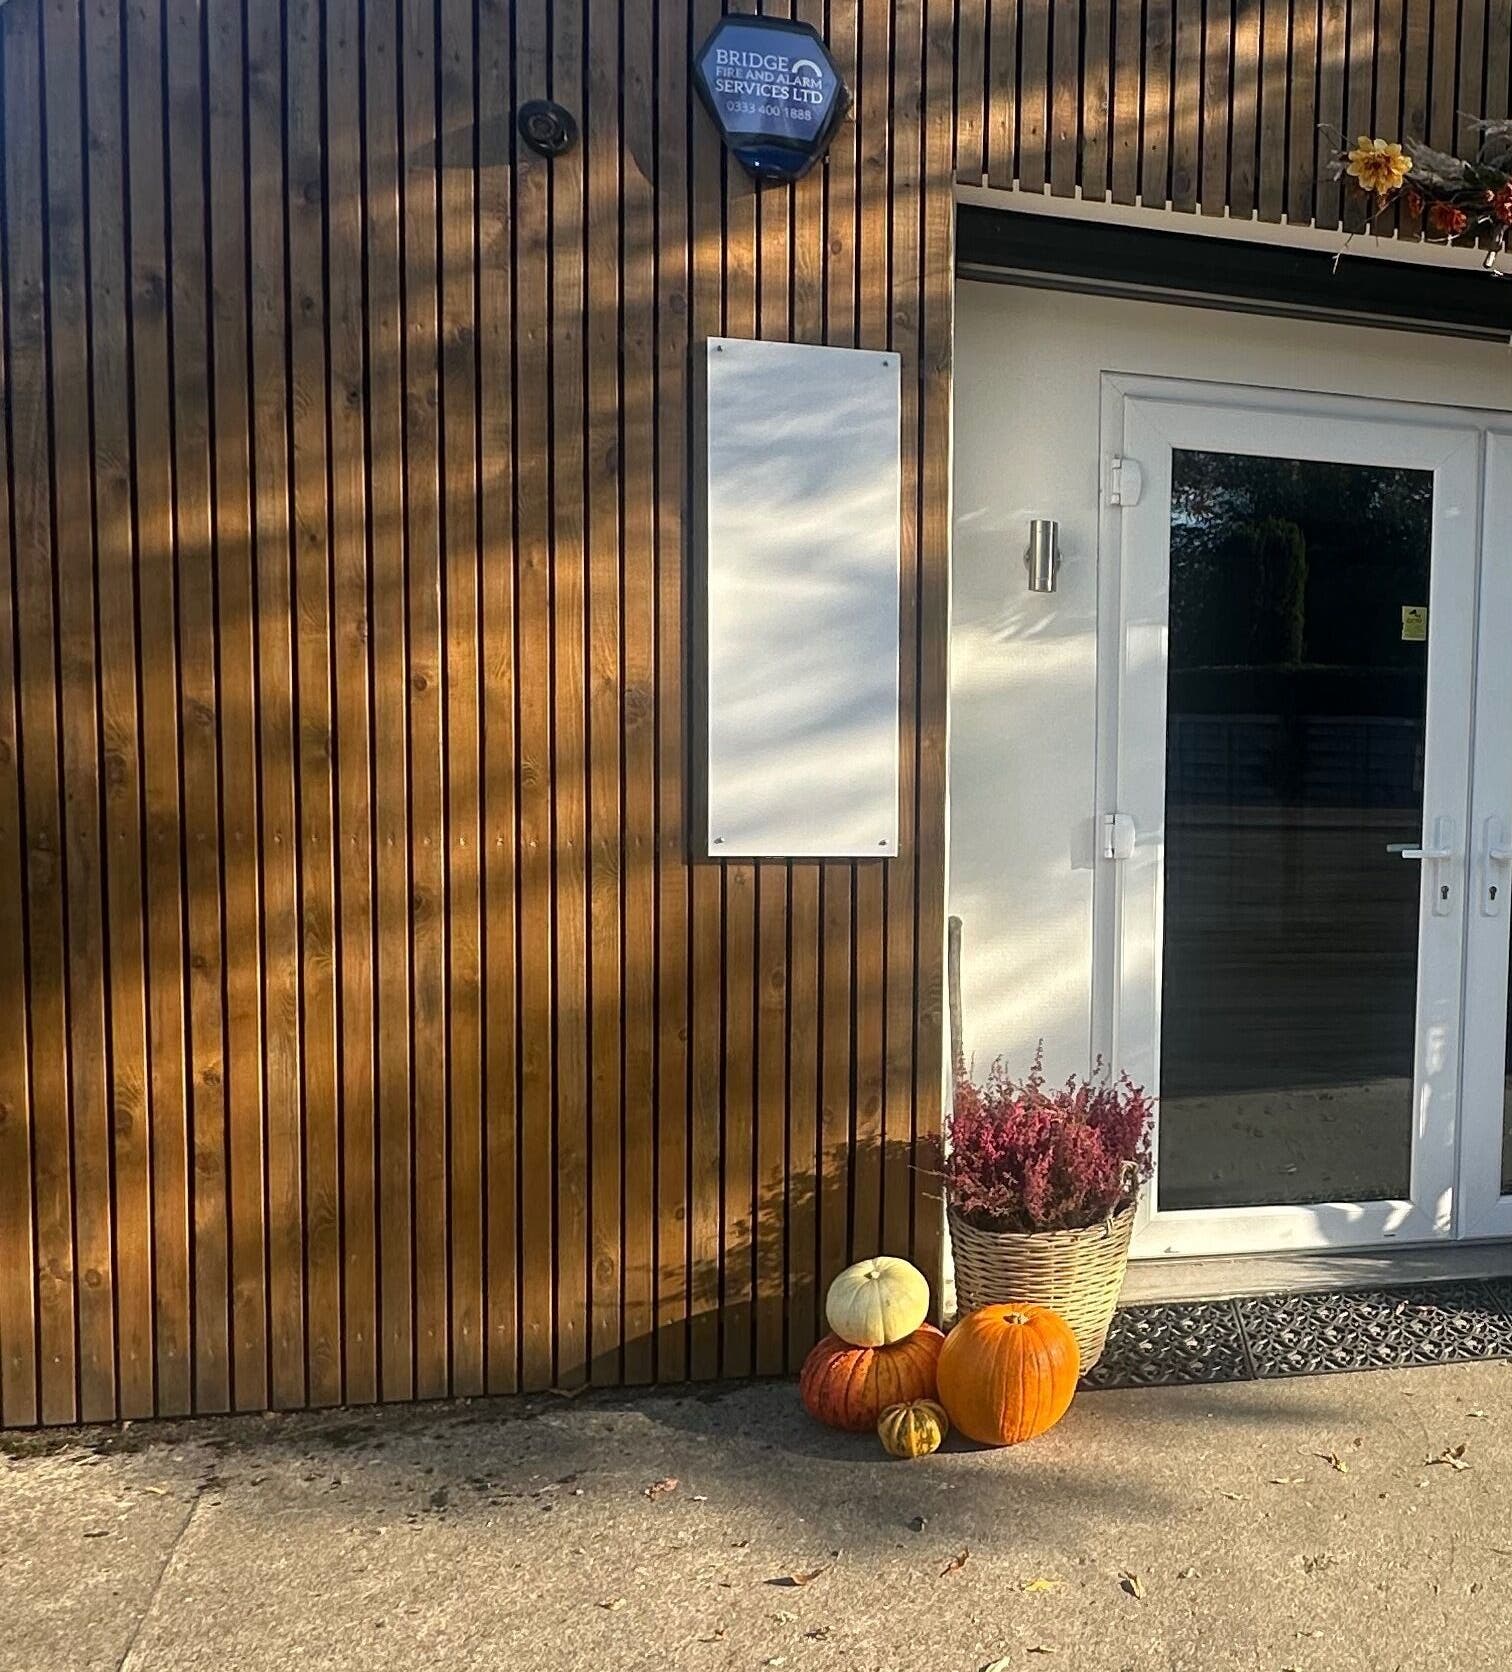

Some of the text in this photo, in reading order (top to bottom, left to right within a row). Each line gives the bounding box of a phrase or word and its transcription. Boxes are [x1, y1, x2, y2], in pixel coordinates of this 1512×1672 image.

[716, 49, 789, 72] BRIDGE
[716, 66, 823, 89] FIRE AND ALARM
[715, 79, 824, 104] SERVICES LTD
[726, 100, 755, 113] 0333
[758, 104, 780, 117] 400
